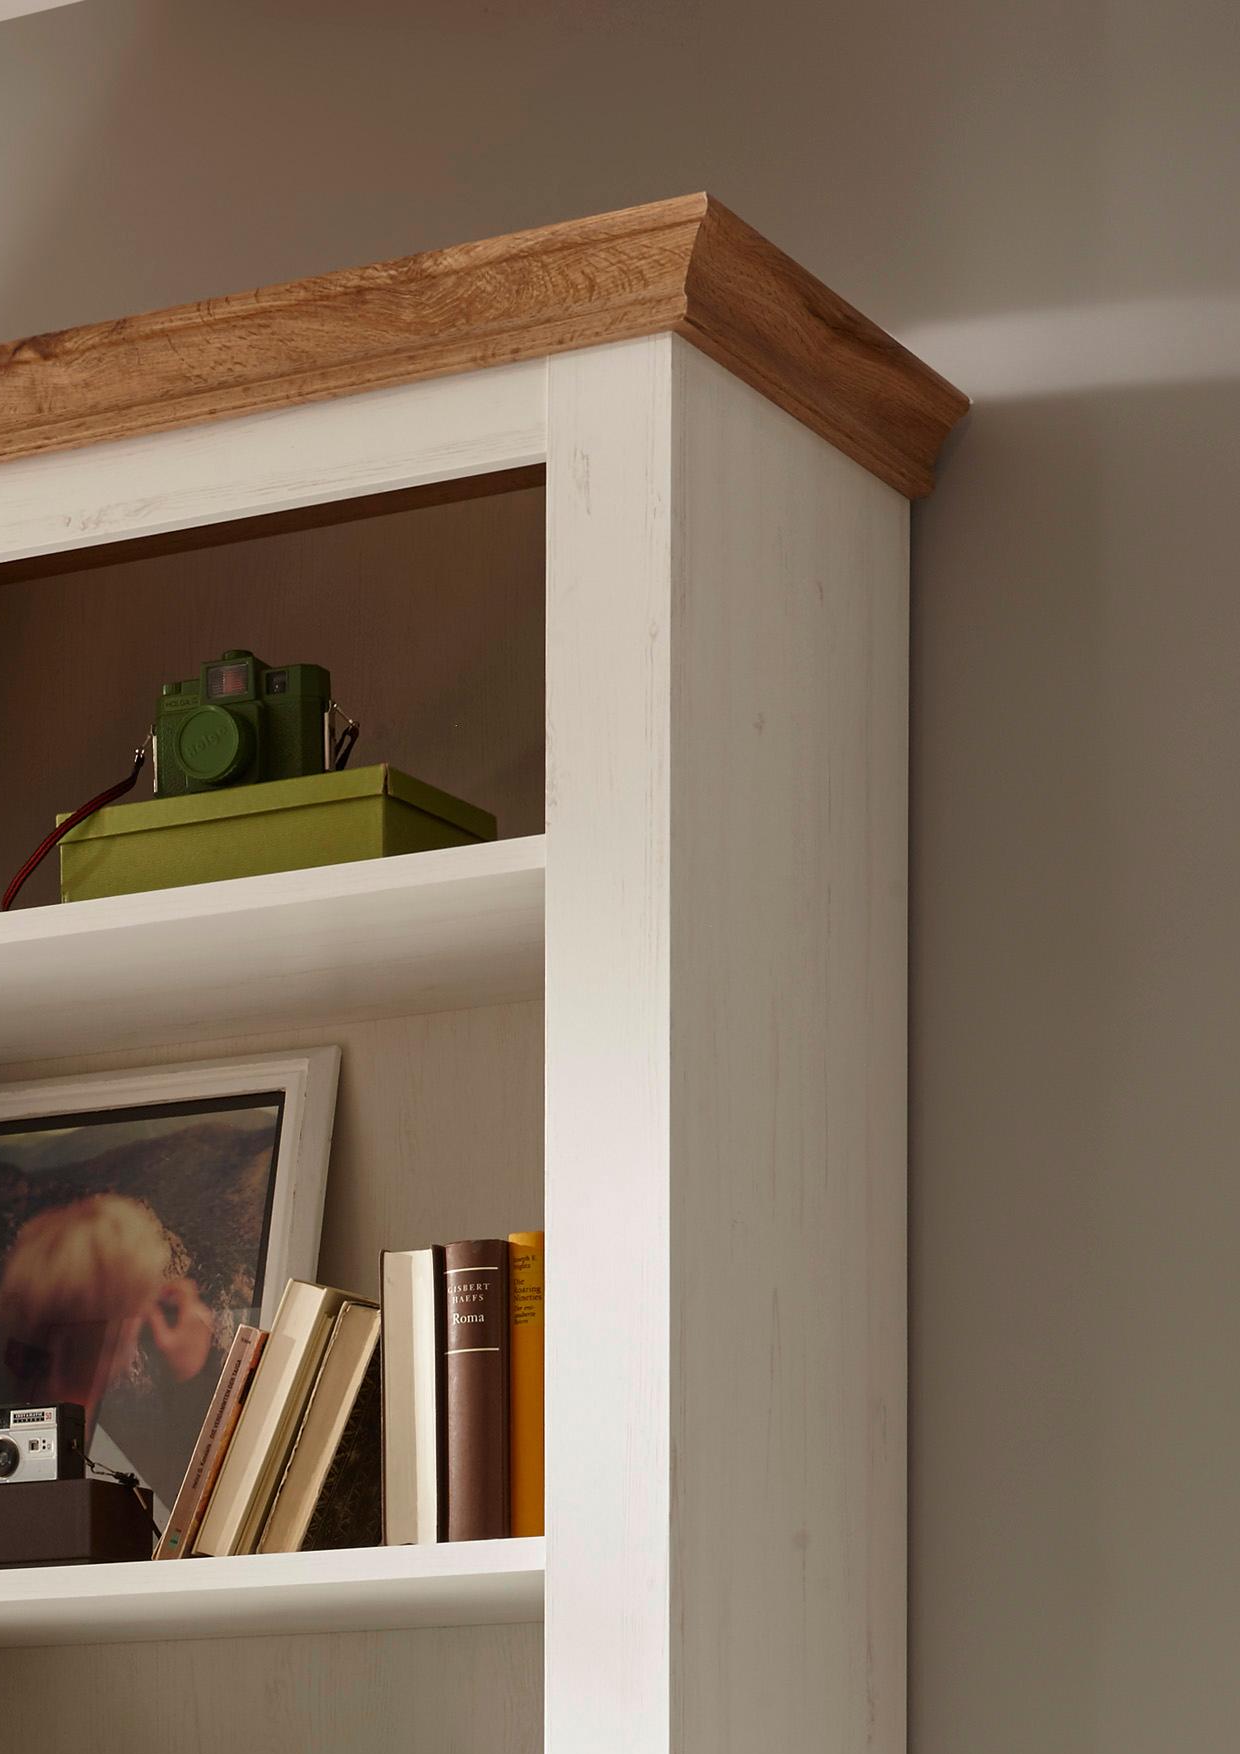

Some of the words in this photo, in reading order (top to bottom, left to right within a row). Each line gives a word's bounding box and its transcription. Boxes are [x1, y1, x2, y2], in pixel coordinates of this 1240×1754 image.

[447, 1283, 490, 1293] GISBERT
[452, 1294, 484, 1304] HAEFS
[452, 1312, 485, 1325] Roma
